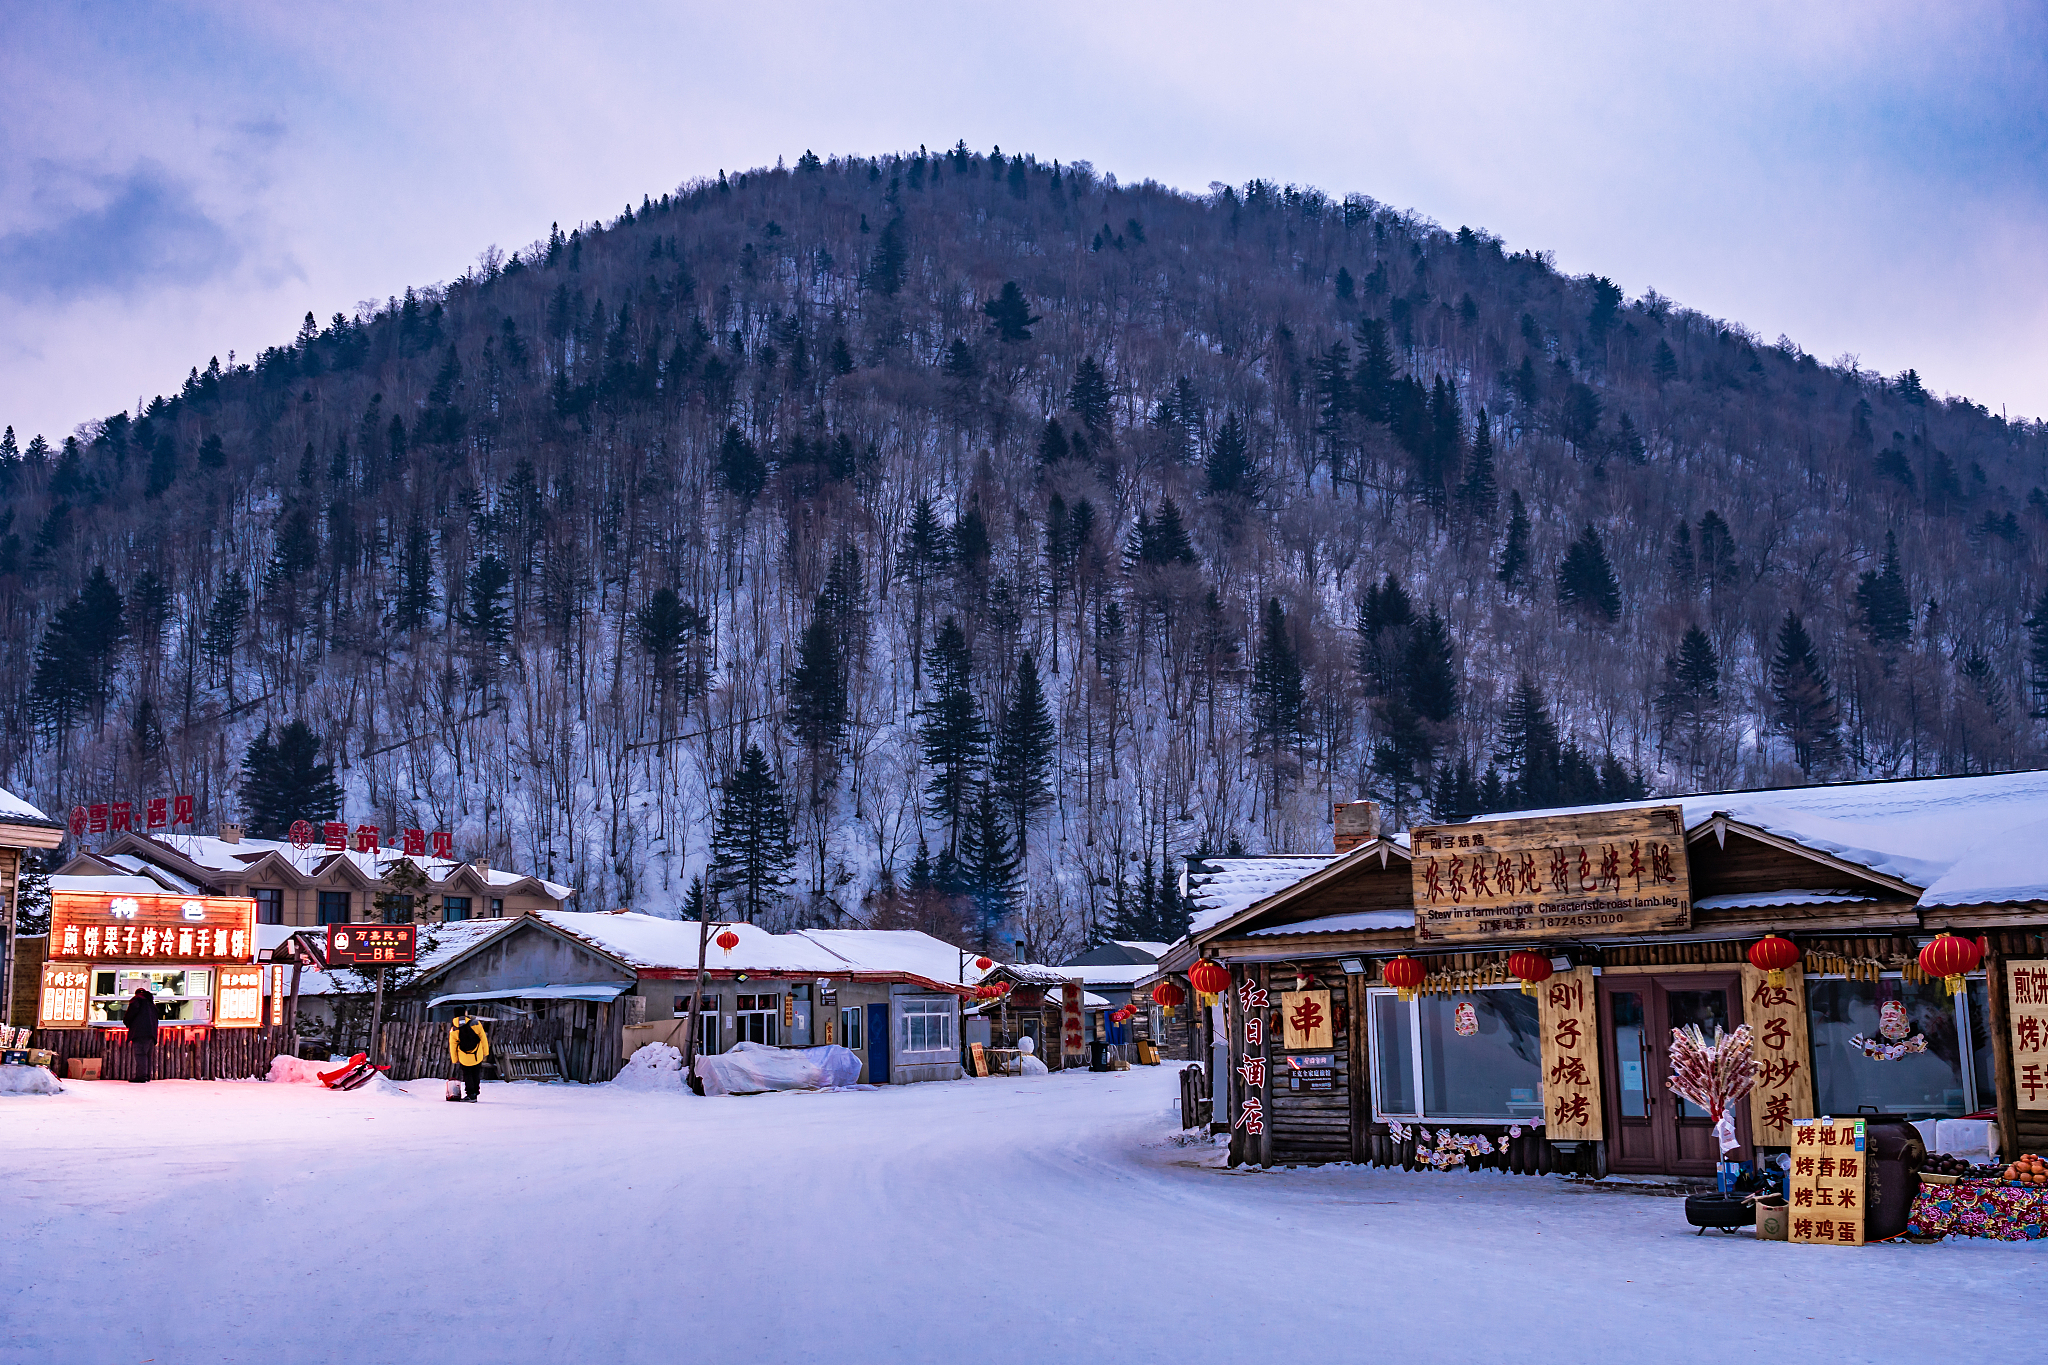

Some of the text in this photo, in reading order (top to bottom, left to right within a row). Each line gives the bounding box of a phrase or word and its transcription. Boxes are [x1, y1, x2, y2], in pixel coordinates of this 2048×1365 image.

[1430, 834, 1485, 850] 刚子烧烤
[110, 897, 206, 920] 特色
[1428, 895, 1678, 920] Stew in a farm iron pot Characteristic roast lamb leg
[1540, 914, 1624, 928] 18724531000
[62, 924, 245, 957] 煎饼果子烤冷面手抓饼
[355, 930, 408, 941] 万嘉民宿
[1290, 996, 1324, 1042] 串
[1234, 978, 1270, 1135] 红日酒店
[1549, 979, 1590, 1127] 刚子烧烤
[1751, 979, 1801, 1132] 饺子炒菜
[2022, 1064, 2048, 1101] 手
[1797, 1126, 1855, 1146] 烤地瓜
[1795, 1157, 1858, 1178] 烤香肠
[1794, 1187, 1856, 1208] 烤玉米
[1794, 1218, 1856, 1242] 烤鸡蛋
